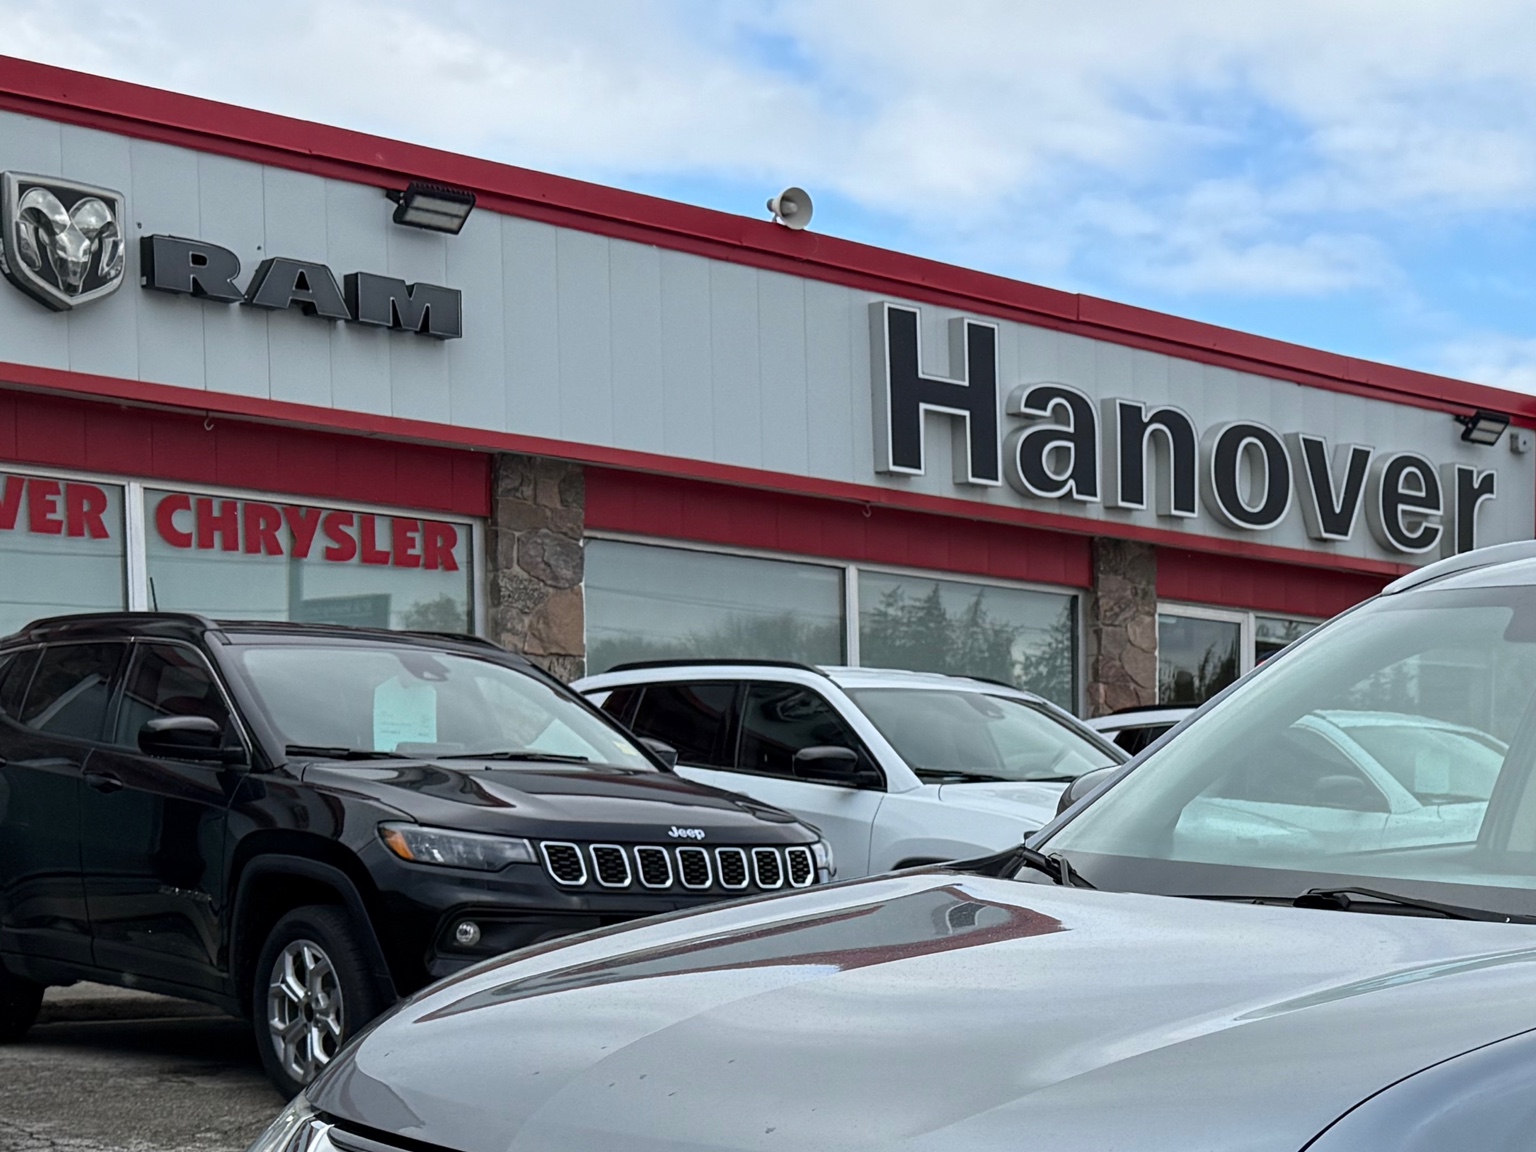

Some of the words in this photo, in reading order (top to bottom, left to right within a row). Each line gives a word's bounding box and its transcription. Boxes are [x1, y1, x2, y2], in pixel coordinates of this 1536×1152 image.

[140, 233, 462, 339] RAM
[868, 300, 1498, 555] Hanover
[155, 494, 459, 571] CHRYSLER
[668, 826, 705, 840] Jeep
